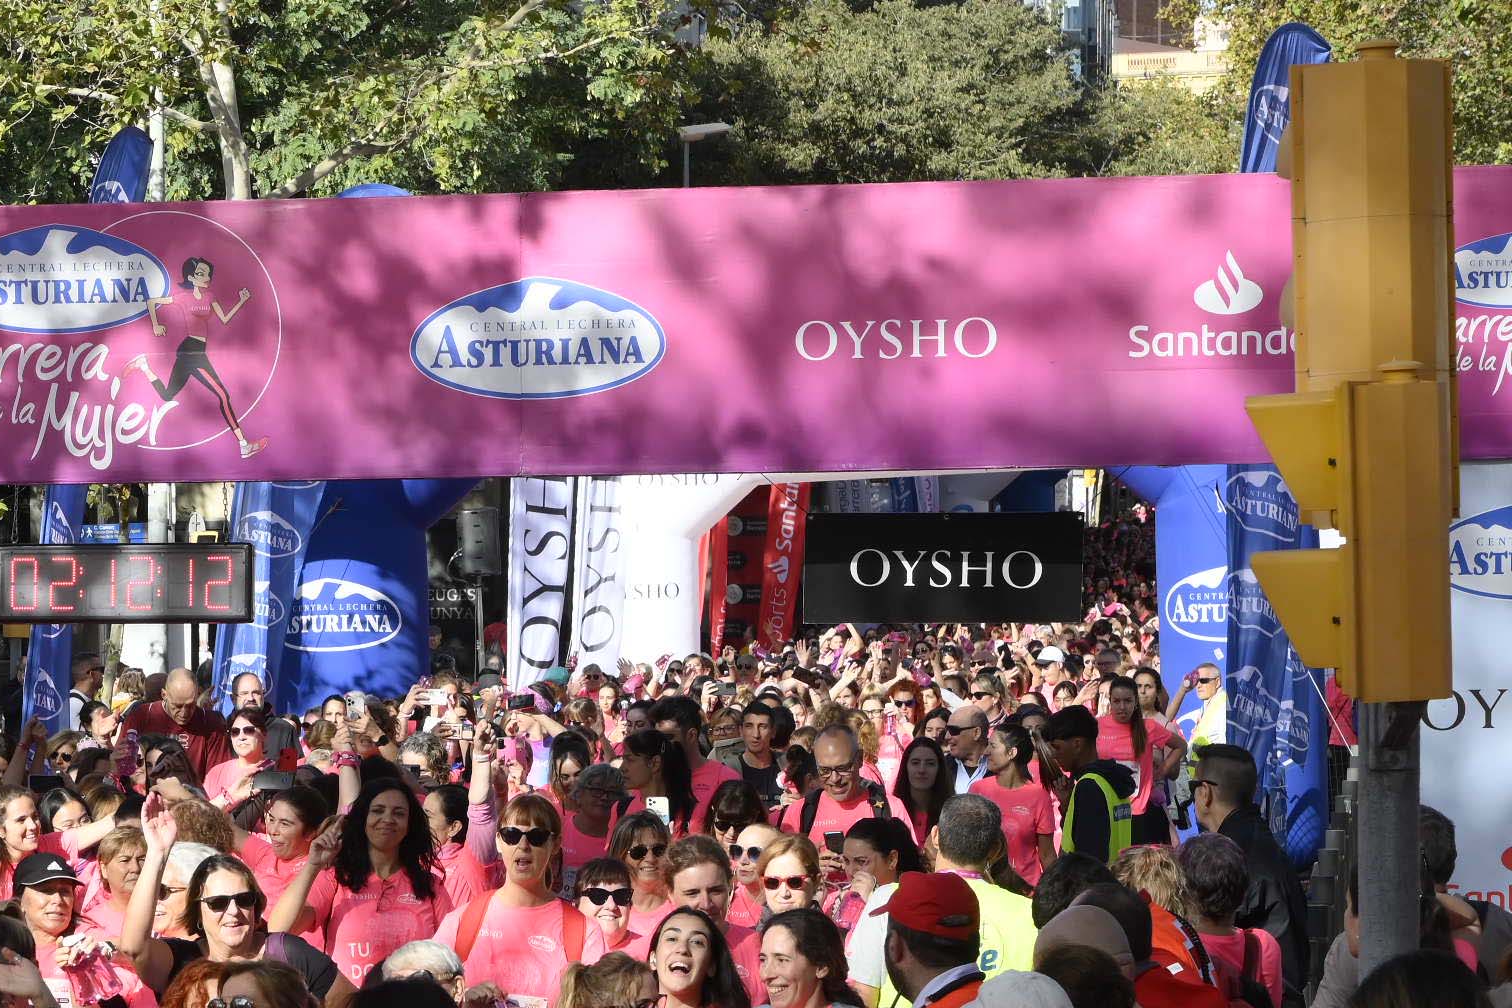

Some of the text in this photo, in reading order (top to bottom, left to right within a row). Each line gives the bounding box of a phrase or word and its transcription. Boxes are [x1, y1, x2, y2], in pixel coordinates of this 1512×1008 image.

[73, 261, 145, 273] LECHERA
[470, 318, 636, 331] CENTRAL LECHERA
[795, 317, 998, 361] OYSHO
[1129, 324, 1295, 358] Santand
[430, 325, 646, 369] ASTURIANA
[1478, 343, 1497, 371] la
[11, 386, 35, 425] la
[30, 376, 179, 470] Mujer
[1476, 536, 1505, 546] CEN
[10, 555, 233, 611] 02:12:12
[520, 477, 568, 670] OYSH
[580, 477, 621, 653] OYSH
[849, 548, 1043, 590] OYSHO
[339, 603, 388, 612] LECHERA
[1172, 594, 1229, 623] ASTU
[1421, 690, 1508, 730] OY
[348, 942, 370, 958] TU
